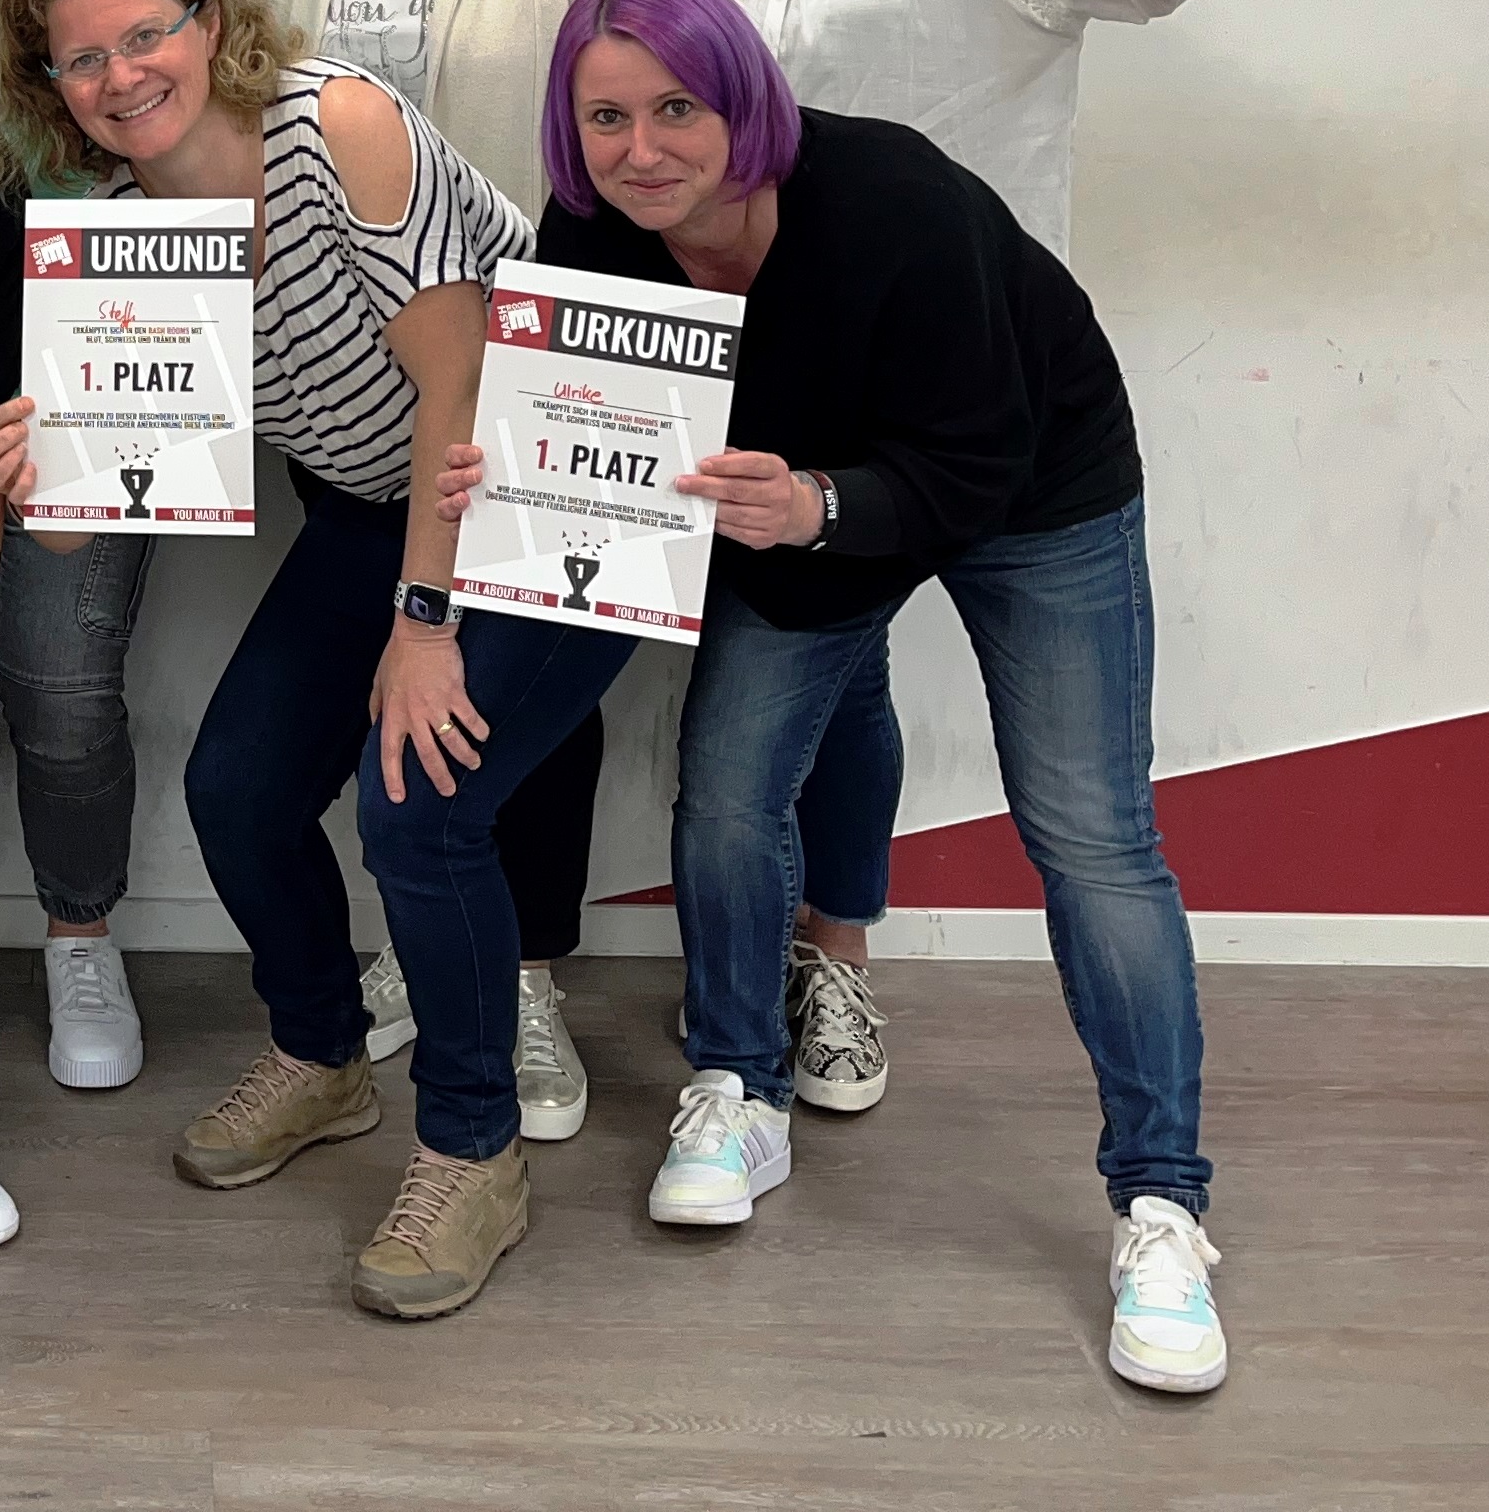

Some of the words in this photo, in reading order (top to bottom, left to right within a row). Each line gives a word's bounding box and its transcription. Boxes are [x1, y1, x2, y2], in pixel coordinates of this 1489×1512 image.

[90, 235, 246, 272] URKUNDE
[560, 307, 732, 373] URKUNDE
[81, 362, 102, 391] 1.
[114, 362, 194, 392] PLATZ
[554, 381, 604, 405] Ulrike
[536, 439, 558, 471] 1.
[570, 443, 659, 488] PLATZ
[132, 474, 140, 490] 1
[33, 506, 49, 517] ALL
[52, 507, 81, 518] ABOUT
[83, 507, 109, 519] SKILL
[173, 509, 193, 520] YOU
[195, 510, 221, 521] MADE
[223, 510, 234, 521] IT!
[824, 489, 837, 519] BASH
[576, 563, 585, 579] 1
[463, 580, 481, 594] ALL
[483, 584, 516, 600] ABOUT
[518, 589, 544, 604] SKILL
[614, 605, 635, 620] YOU
[637, 610, 665, 625] MADE
[667, 615, 680, 628] IT!
